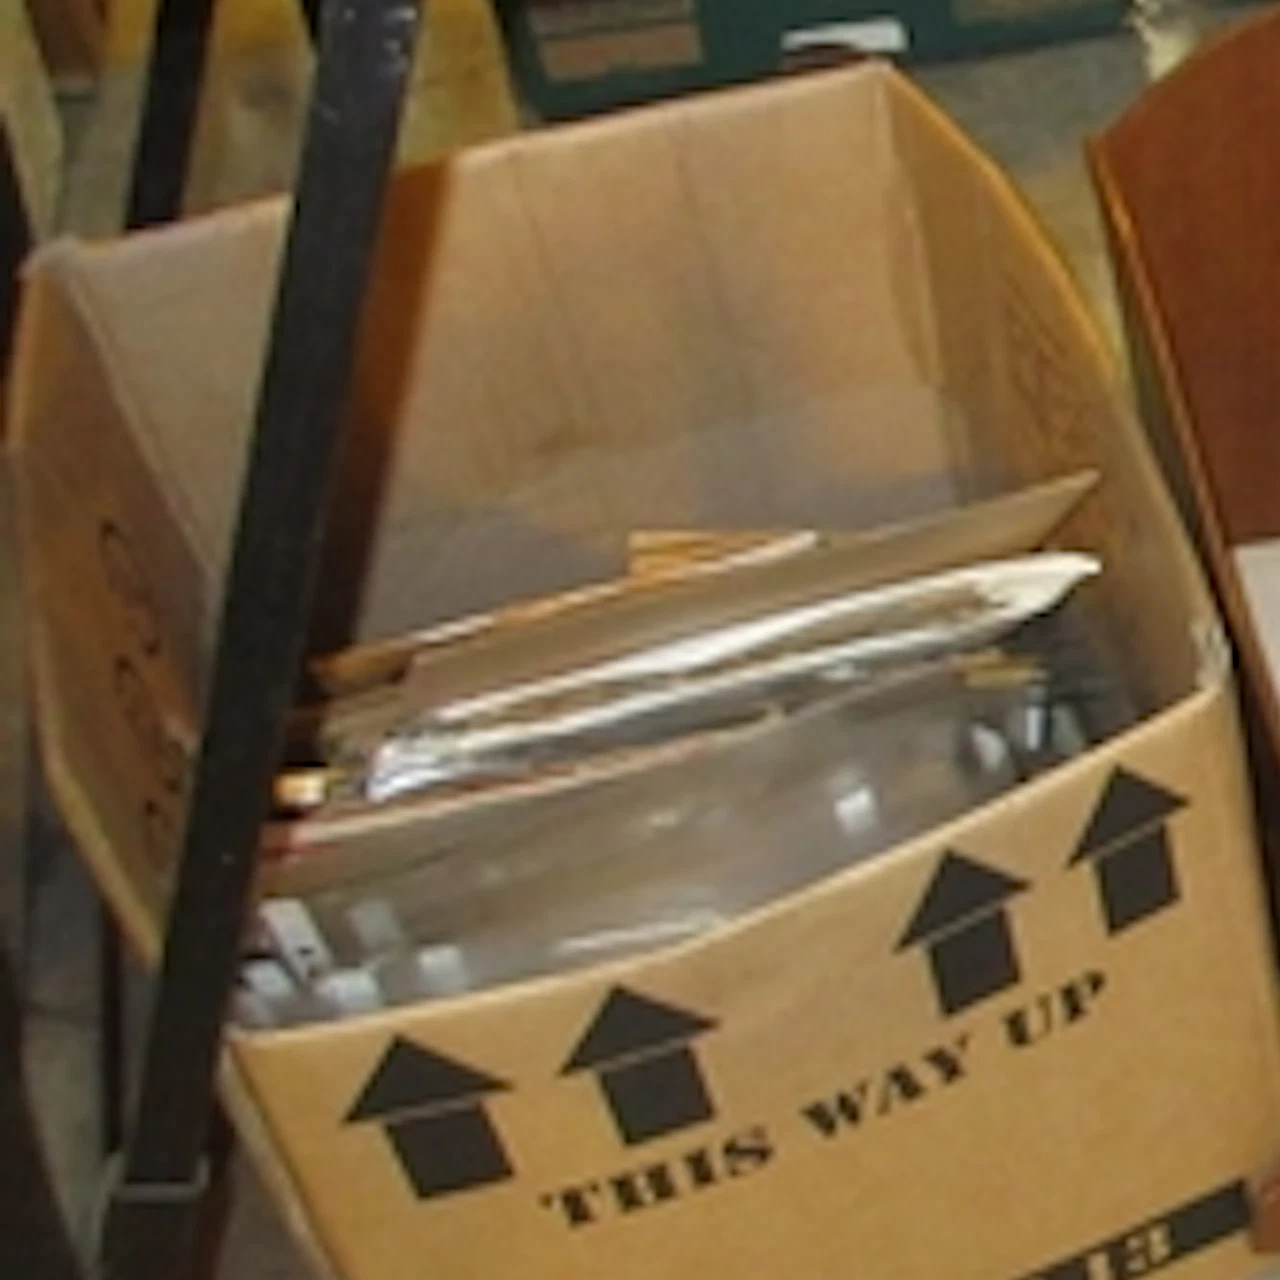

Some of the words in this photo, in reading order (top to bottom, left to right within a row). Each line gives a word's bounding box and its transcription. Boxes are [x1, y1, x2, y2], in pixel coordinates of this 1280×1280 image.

[540, 1126, 775, 1229] THIS
[802, 1032, 973, 1140] WAY
[1002, 968, 1107, 1048] UP
